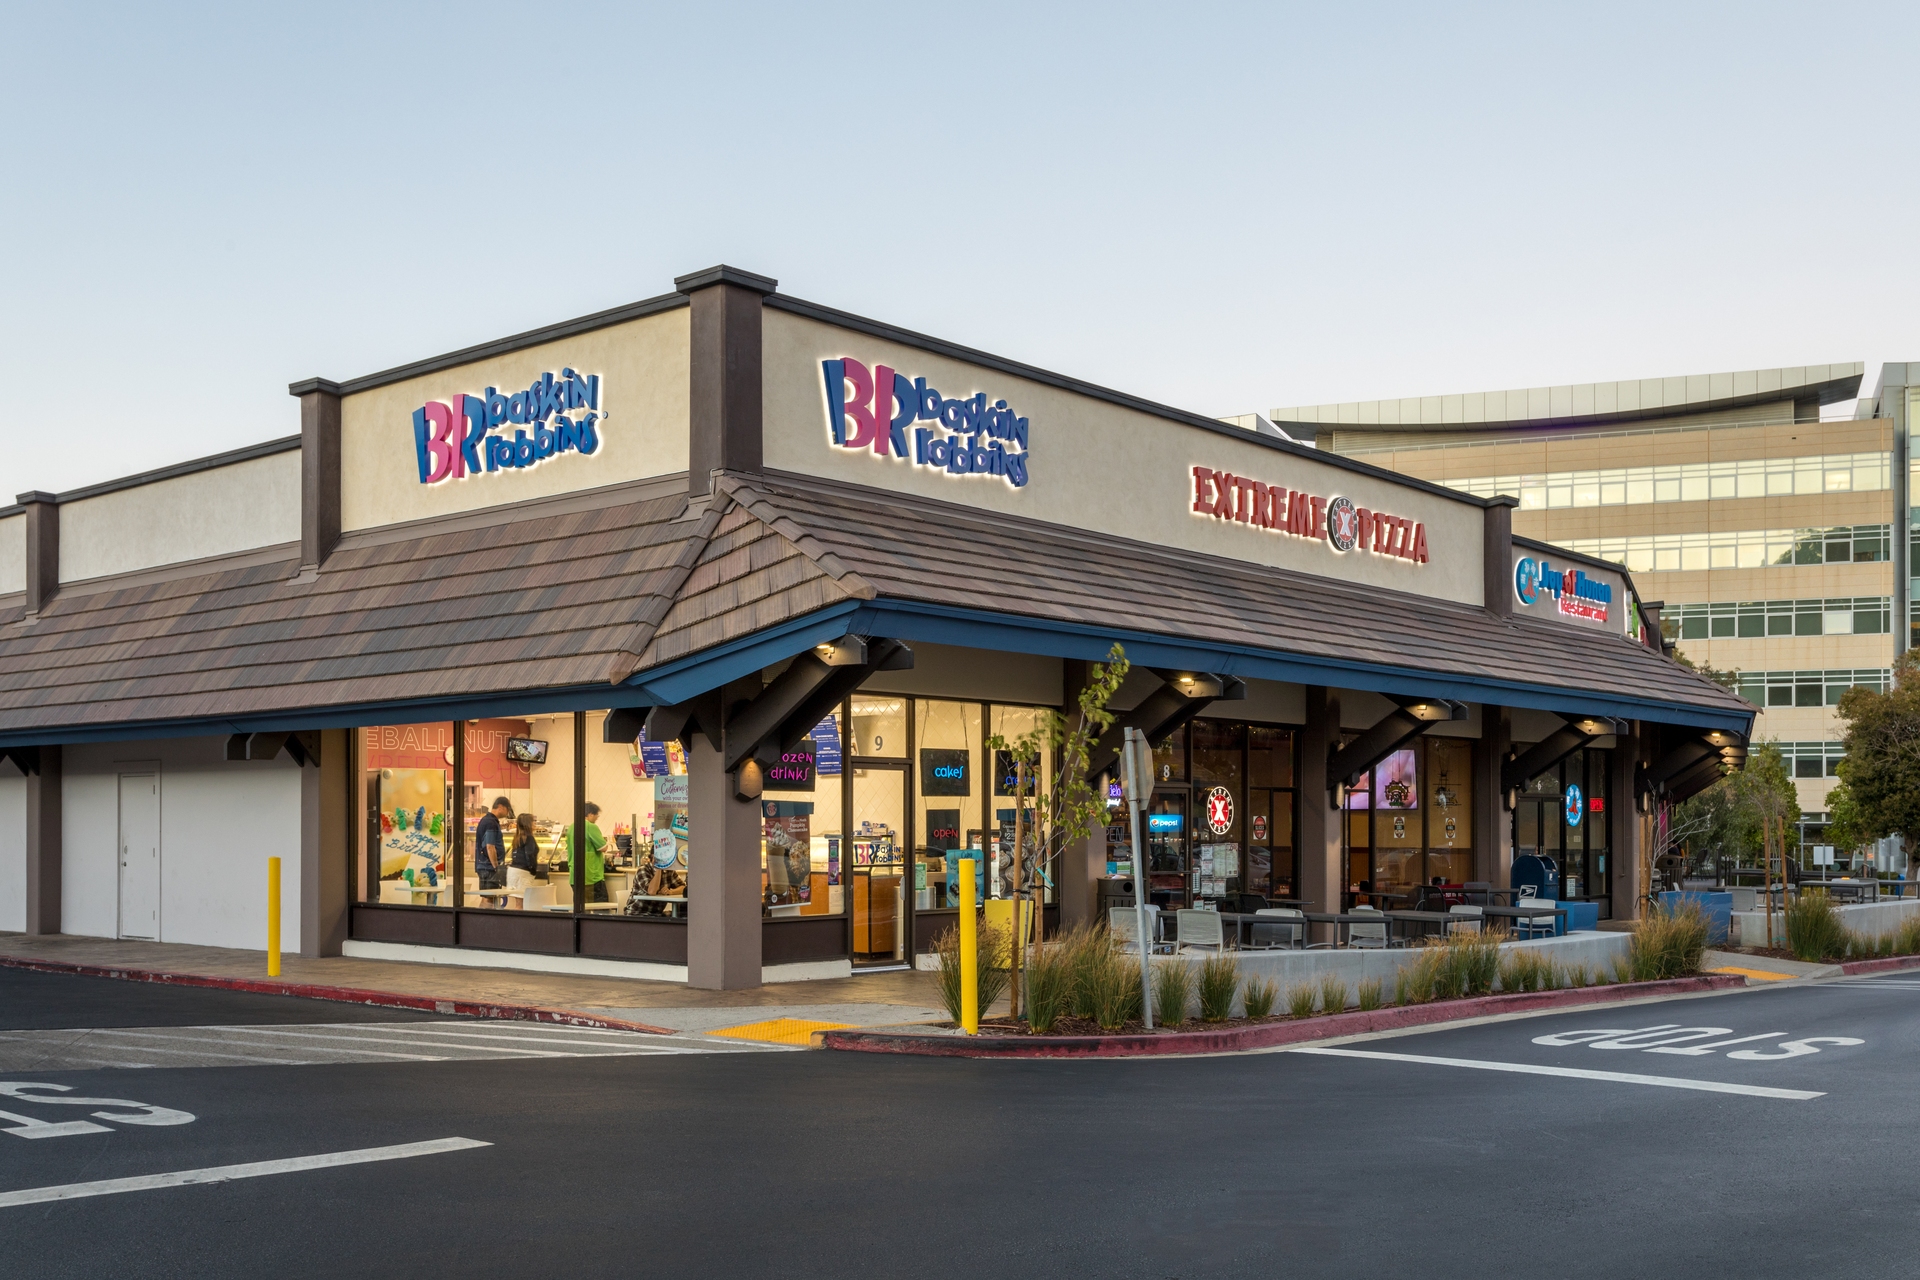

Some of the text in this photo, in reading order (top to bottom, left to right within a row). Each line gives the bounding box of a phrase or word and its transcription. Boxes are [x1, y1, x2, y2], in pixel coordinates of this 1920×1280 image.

[822, 357, 918, 457] BR
[412, 394, 487, 483] BR
[1193, 466, 1430, 563] EXTREME PIZZA
[1539, 562, 1563, 599] Joy
[1562, 570, 1577, 594] of
[1576, 570, 1612, 603] Hunan
[1560, 597, 1608, 621] Restaurant
[875, 735, 884, 751] 9
[934, 765, 964, 779] cakes
[1163, 764, 1170, 778] 8
[1160, 819, 1178, 827] pepsi
[933, 829, 959, 840] open
